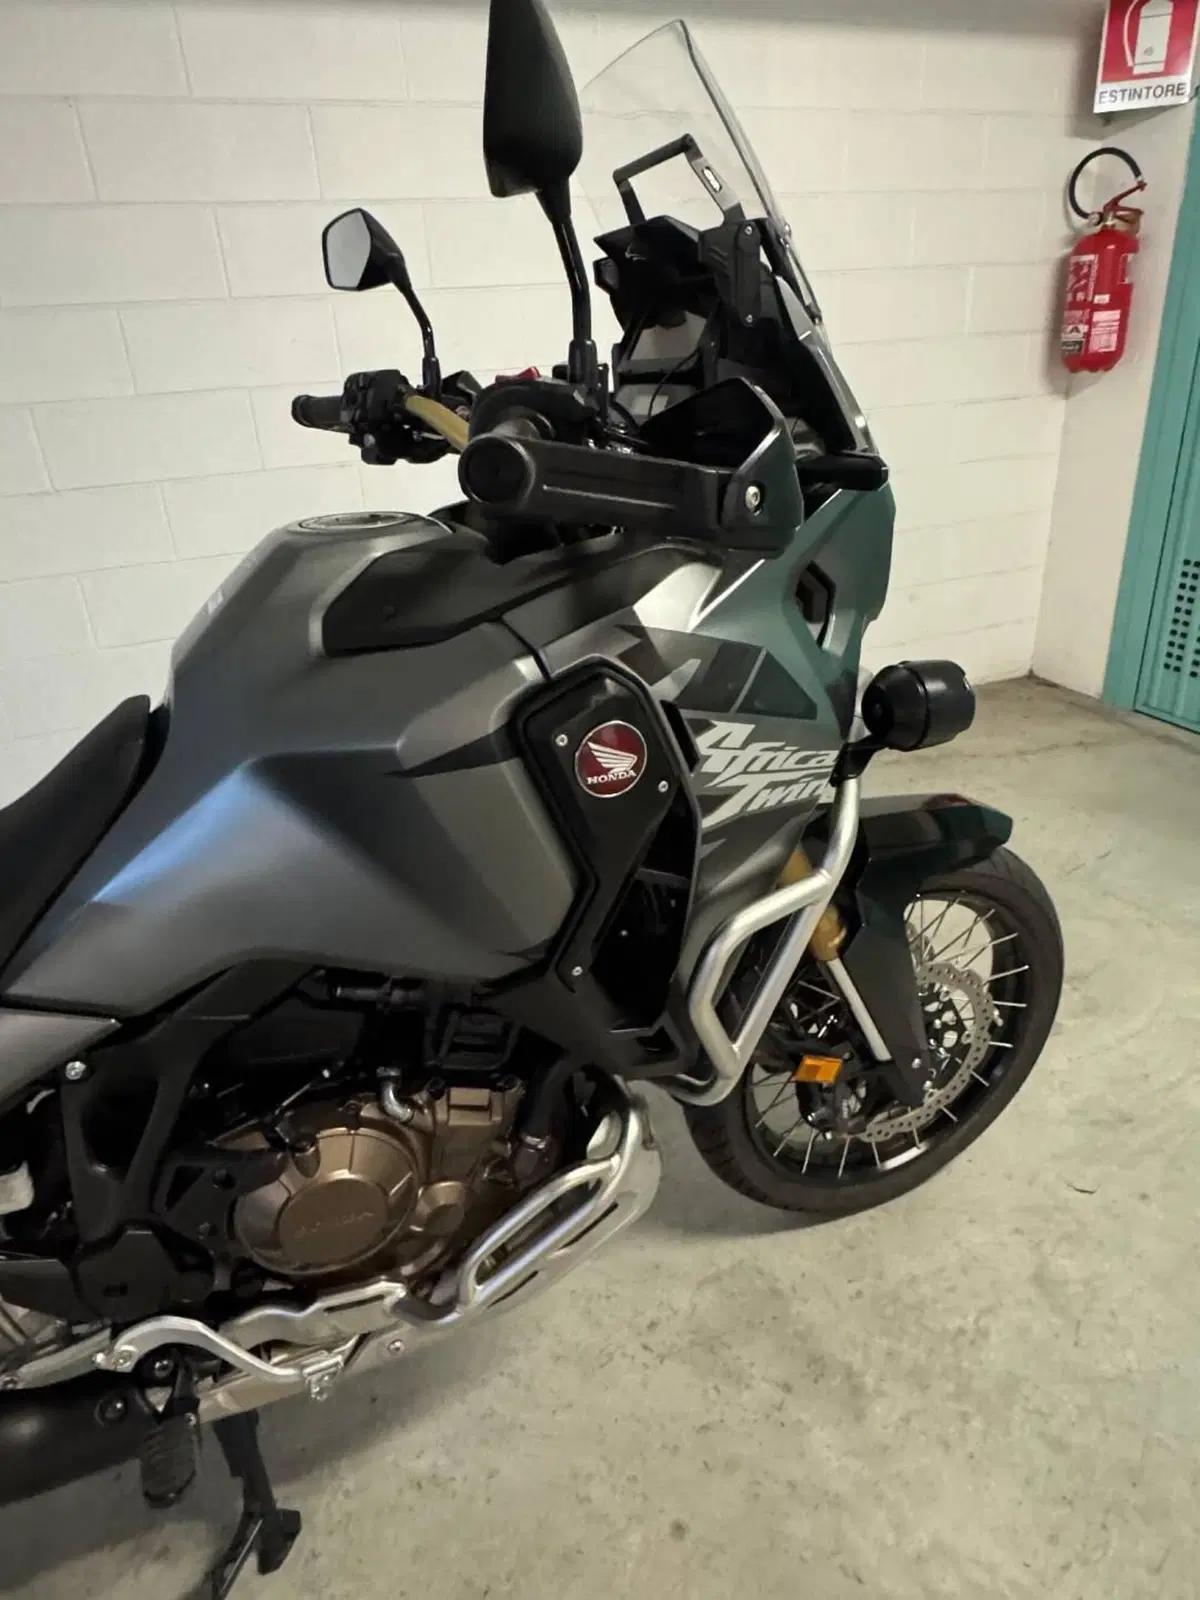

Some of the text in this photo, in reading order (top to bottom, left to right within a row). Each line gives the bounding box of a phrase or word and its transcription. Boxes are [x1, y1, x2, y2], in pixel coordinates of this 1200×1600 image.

[1098, 82, 1187, 105] ESTINTORE
[695, 720, 839, 787] Africa
[586, 769, 638, 785] HONDA
